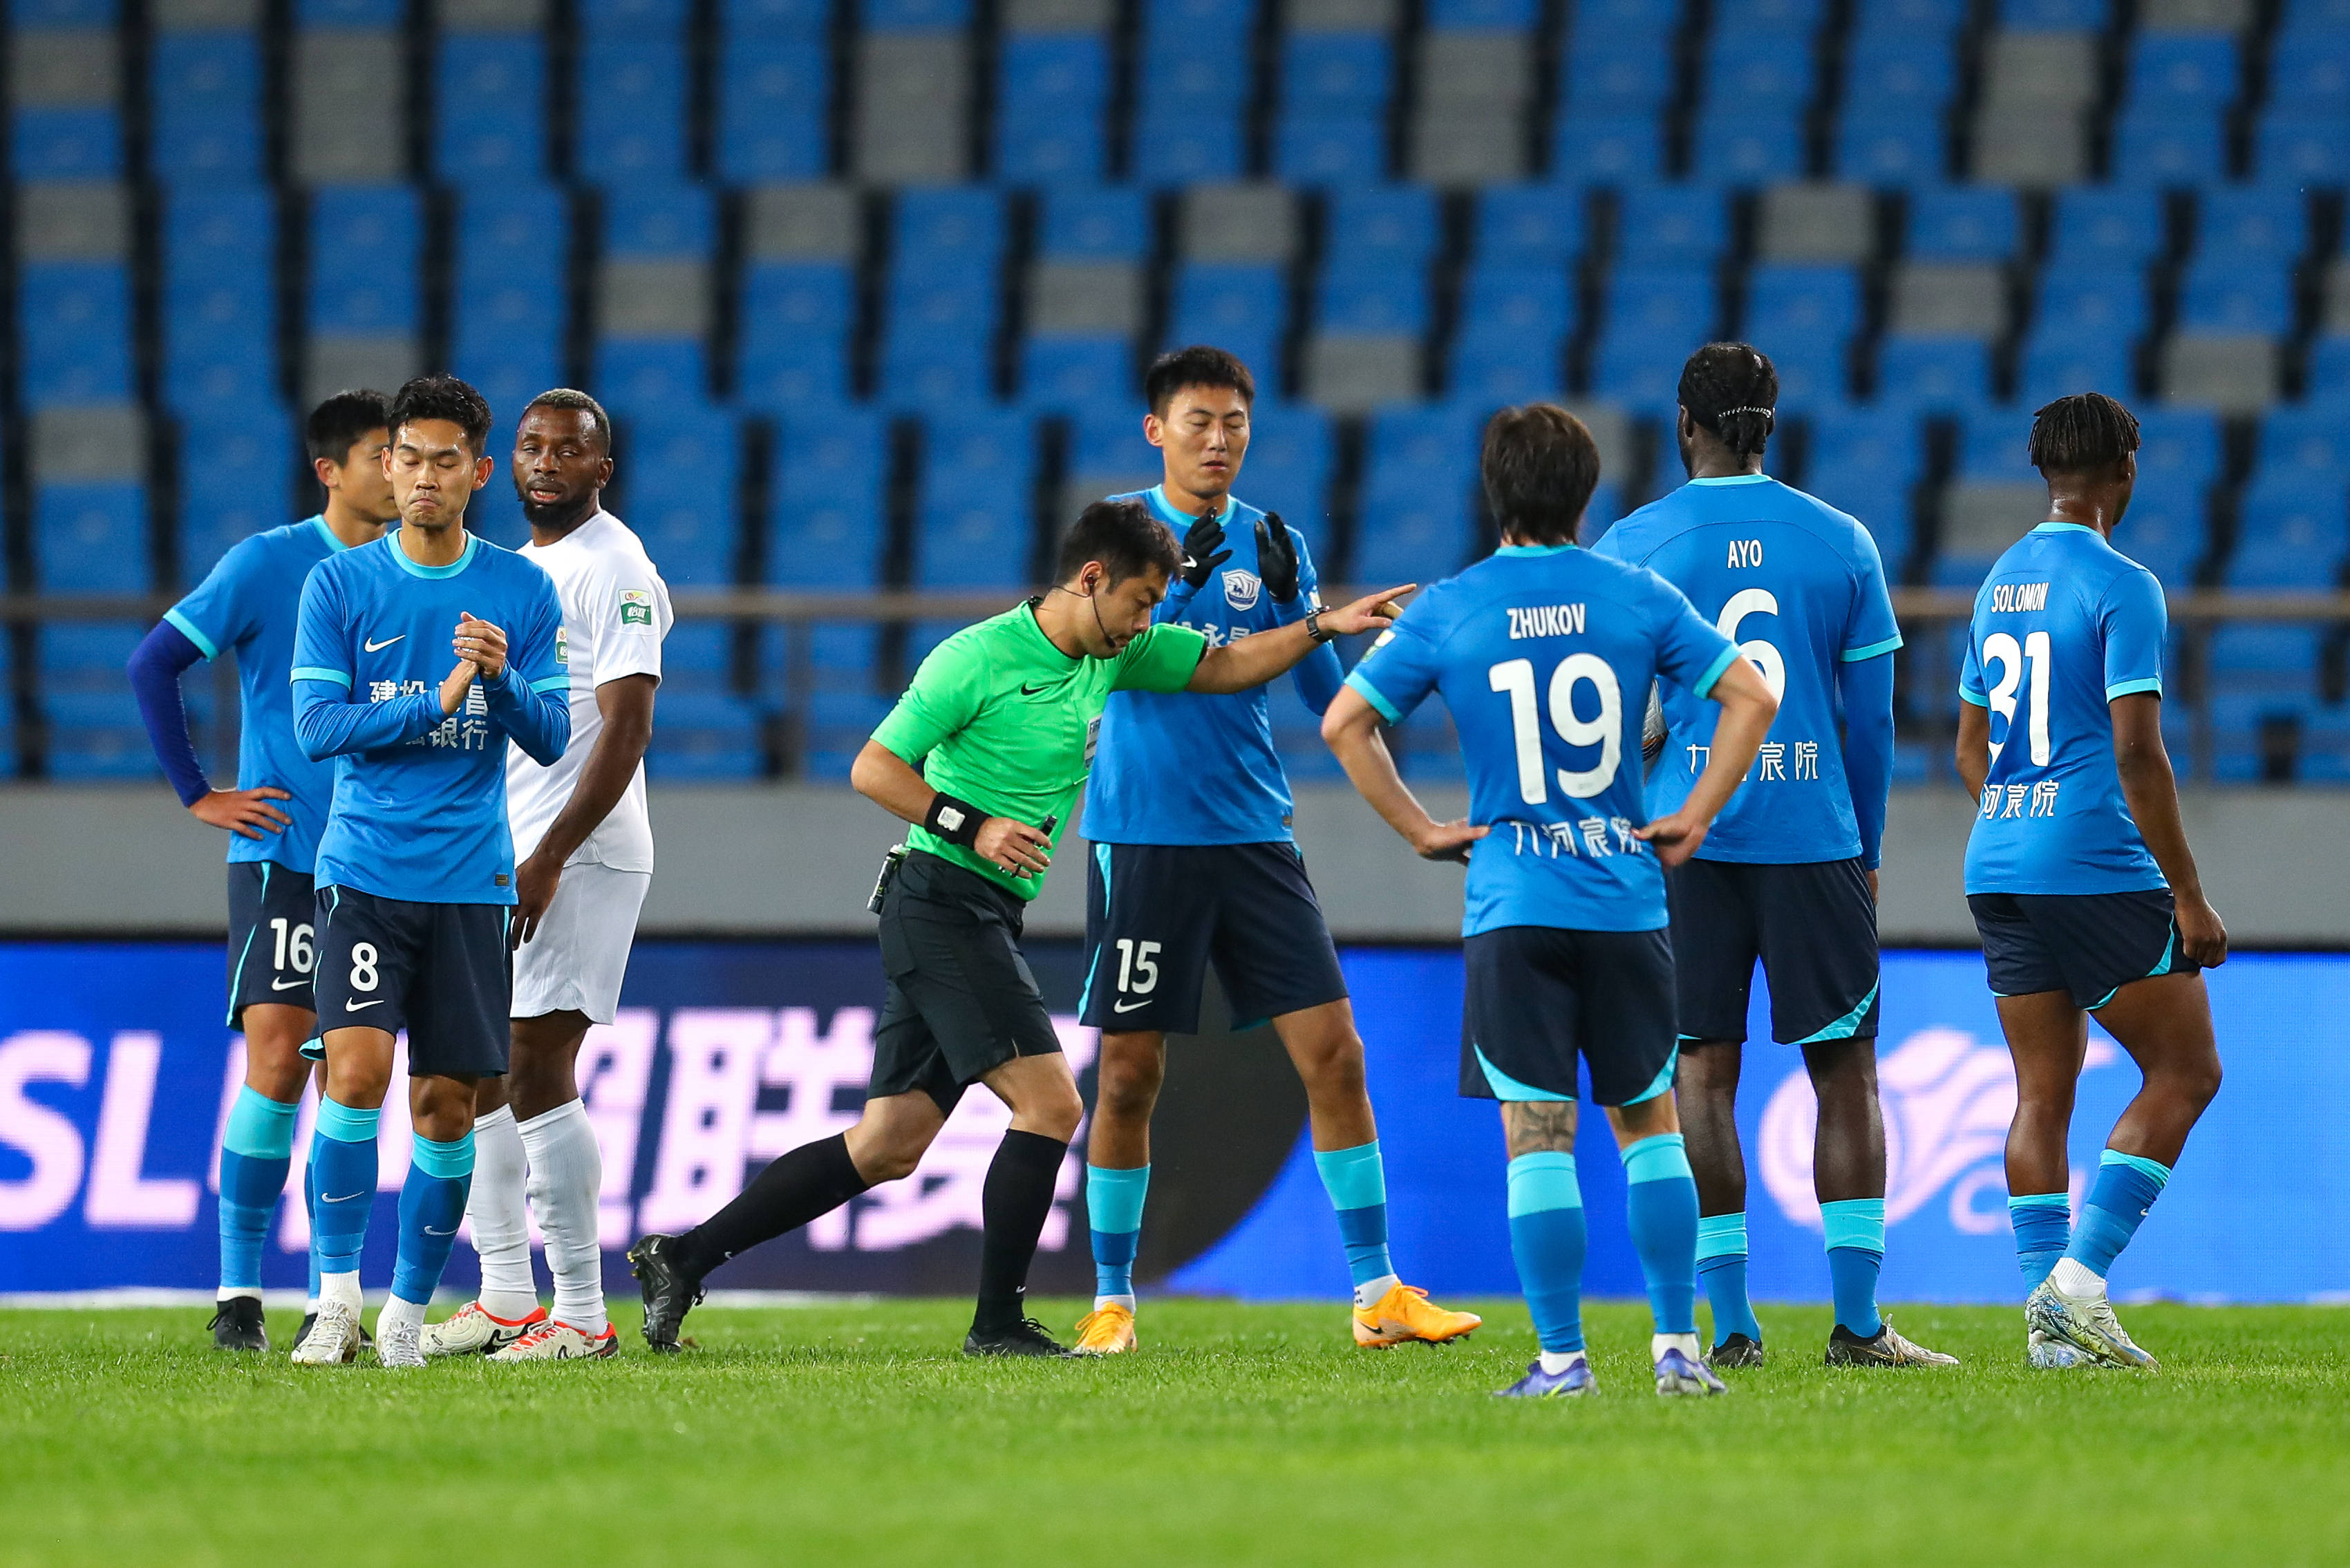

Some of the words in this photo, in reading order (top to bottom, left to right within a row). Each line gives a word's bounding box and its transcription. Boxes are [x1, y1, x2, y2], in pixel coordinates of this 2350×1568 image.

[1727, 539, 1763, 569] AYO
[1991, 582, 2049, 613] SOLOMON
[1506, 603, 1586, 640] ZHUKOV
[1716, 588, 1786, 706] 6
[369, 679, 489, 717] 建投昌
[1982, 631, 2051, 767] 31
[405, 717, 489, 750] 银行
[1489, 652, 1622, 806] 19
[1686, 740, 1818, 782] 九宸院
[270, 918, 314, 974] 16
[350, 942, 379, 992] 8
[1116, 938, 1161, 994] 15
